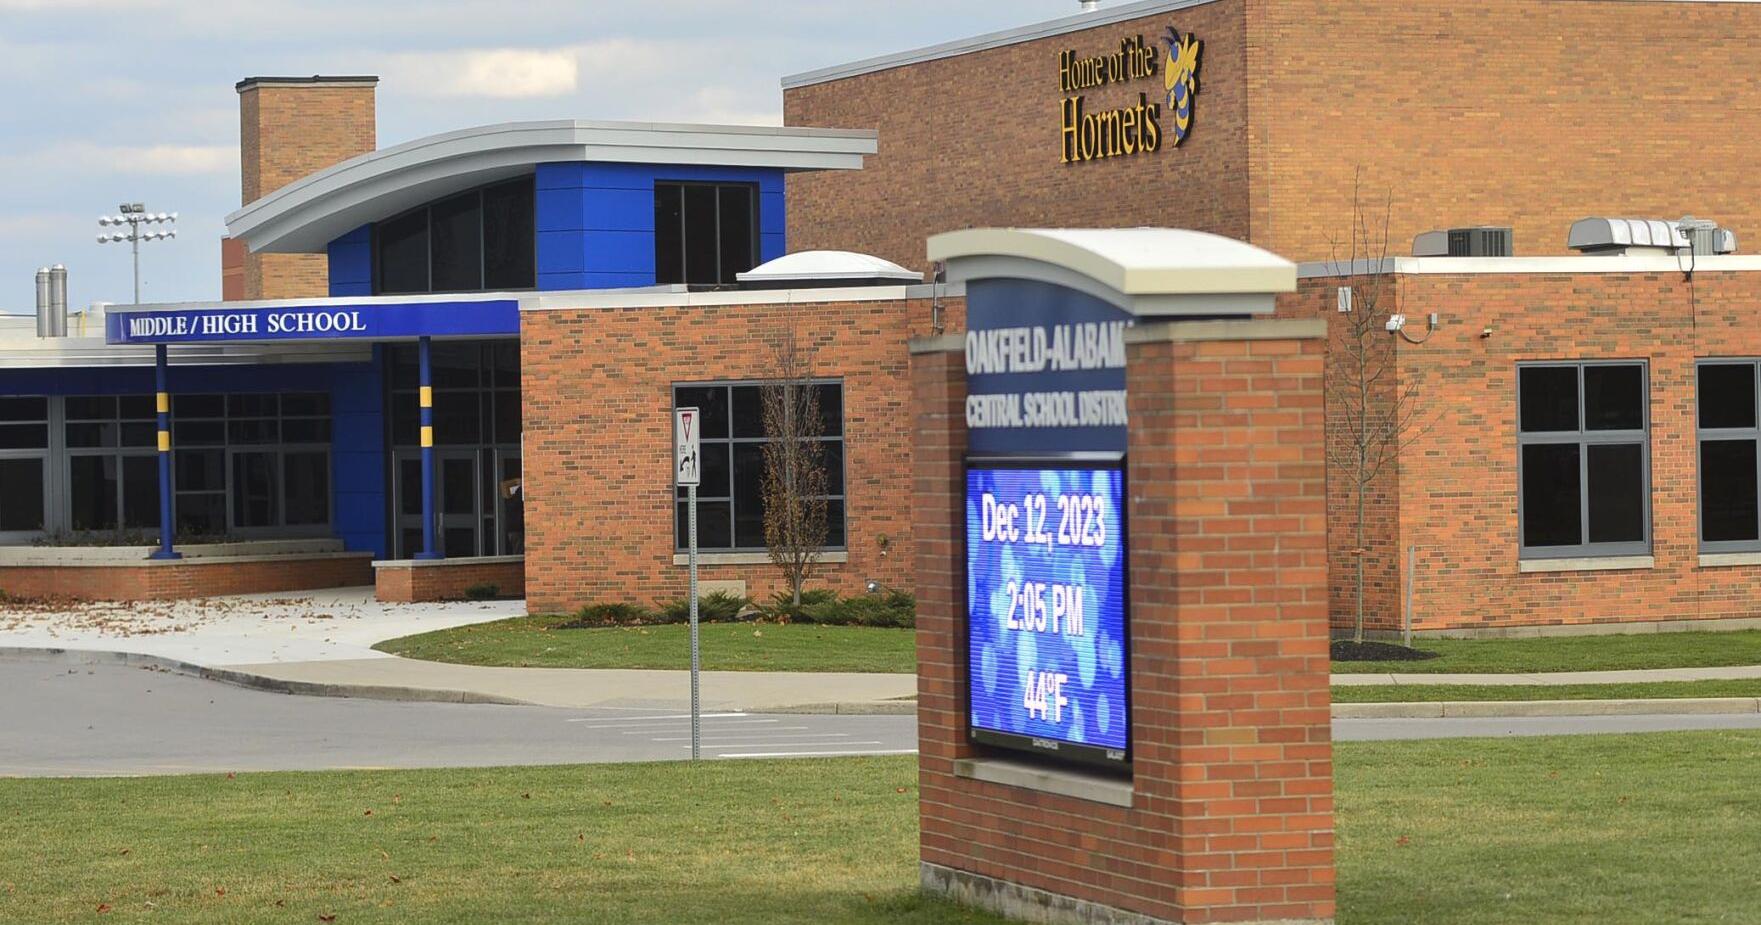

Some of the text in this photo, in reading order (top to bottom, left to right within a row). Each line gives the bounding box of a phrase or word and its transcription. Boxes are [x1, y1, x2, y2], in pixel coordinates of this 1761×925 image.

[1058, 35, 1153, 92] Home of the
[1059, 95, 1158, 164] Hornets
[267, 311, 367, 333] SCHOOL
[965, 319, 1134, 374] OAKFIELD-ALABAM
[966, 393, 1024, 428] CENTRAL
[1023, 391, 1079, 427] SCHOOL
[981, 491, 1107, 554] Dec 12, 2023
[1006, 580, 1084, 637] 2:05 PM
[1023, 669, 1069, 723] 44°F
